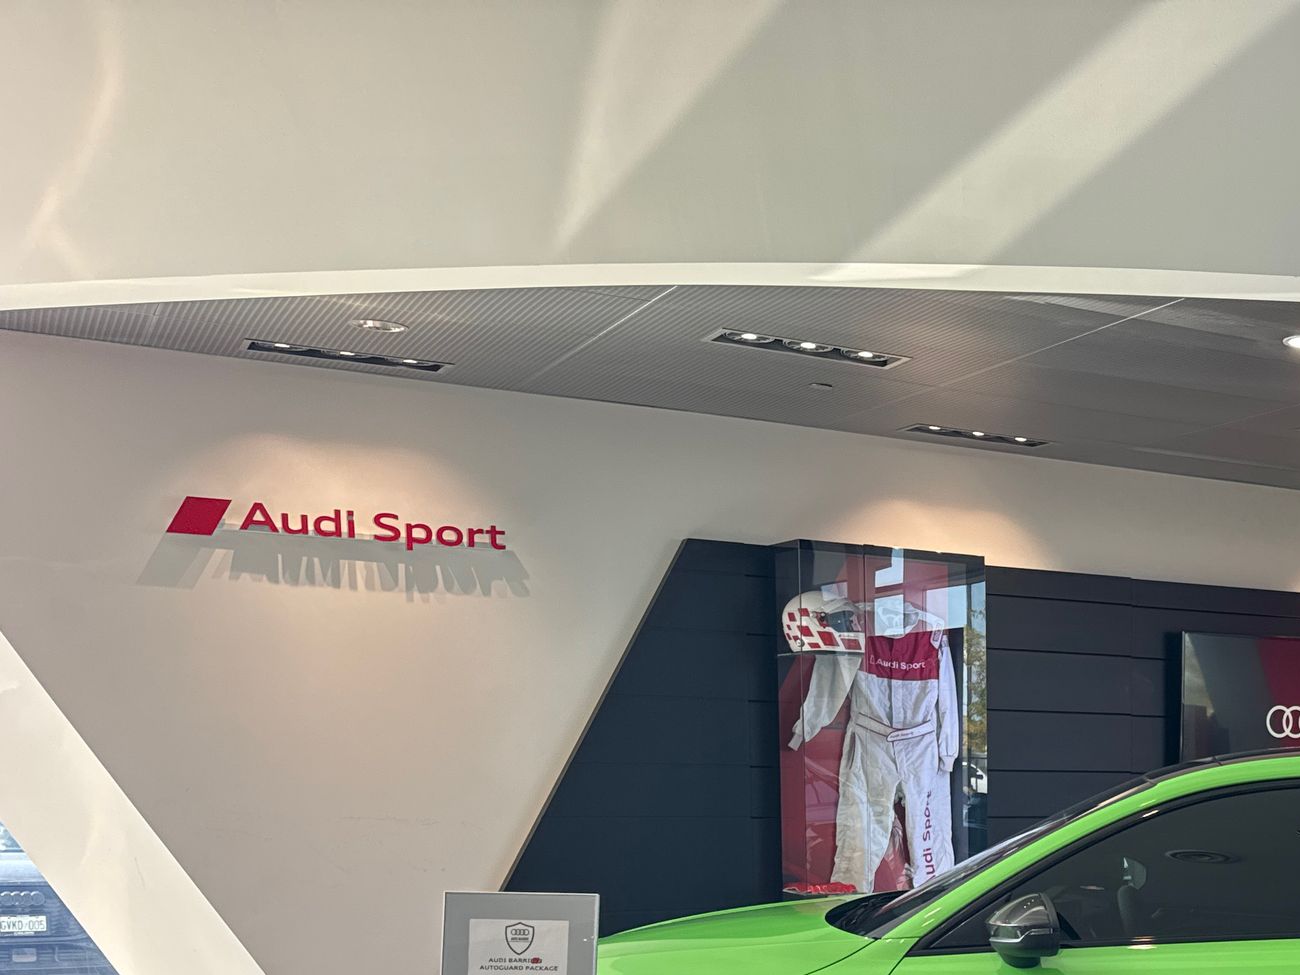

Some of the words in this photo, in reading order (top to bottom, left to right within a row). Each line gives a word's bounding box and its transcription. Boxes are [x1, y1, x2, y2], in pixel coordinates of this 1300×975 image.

[239, 502, 356, 538] Audi
[373, 512, 507, 551] Sport
[876, 658, 899, 669] Audi
[900, 661, 926, 671] Sport
[922, 789, 932, 842] Sport
